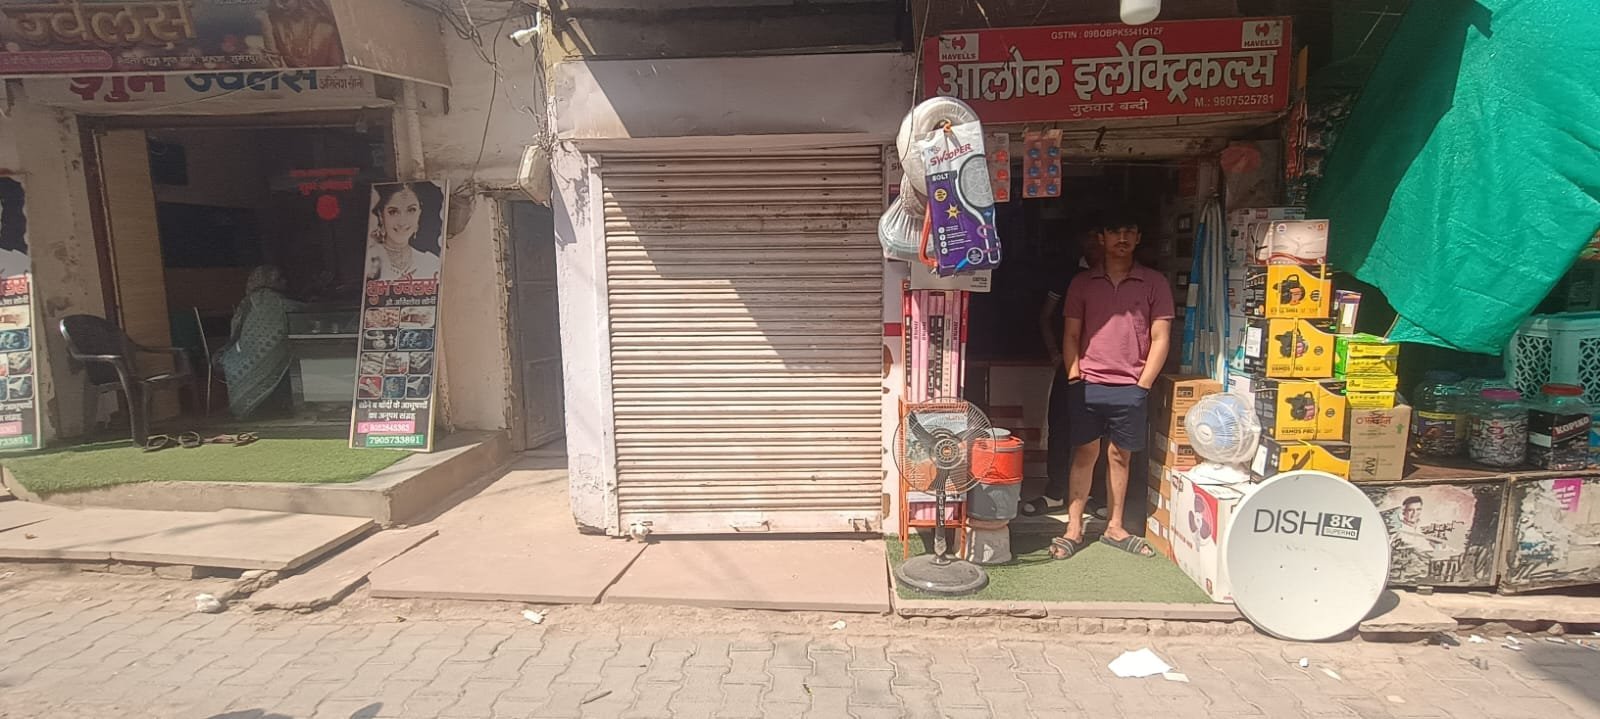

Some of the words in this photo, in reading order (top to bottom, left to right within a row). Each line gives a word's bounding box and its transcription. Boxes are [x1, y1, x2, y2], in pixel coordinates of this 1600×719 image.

[1051, 31, 1078, 40] GSTIN
[1243, 38, 1280, 47] HAVELLS
[941, 53, 977, 61] HAVELLS
[936, 46, 1064, 101] आलोक
[1072, 38, 1278, 103] इलेक्ट्रिकल्स
[1068, 102, 1116, 117] गुरुवार
[1118, 97, 1149, 110] बन्दी
[930, 143, 972, 167] SWOOPER
[932, 173, 949, 182] BOLT
[1554, 416, 1589, 434] KOPIKO
[368, 436, 420, 445] 7905733891
[1254, 509, 1322, 536] DISH
[1329, 515, 1354, 529] 8K
[1325, 527, 1356, 538] SUPERHD
